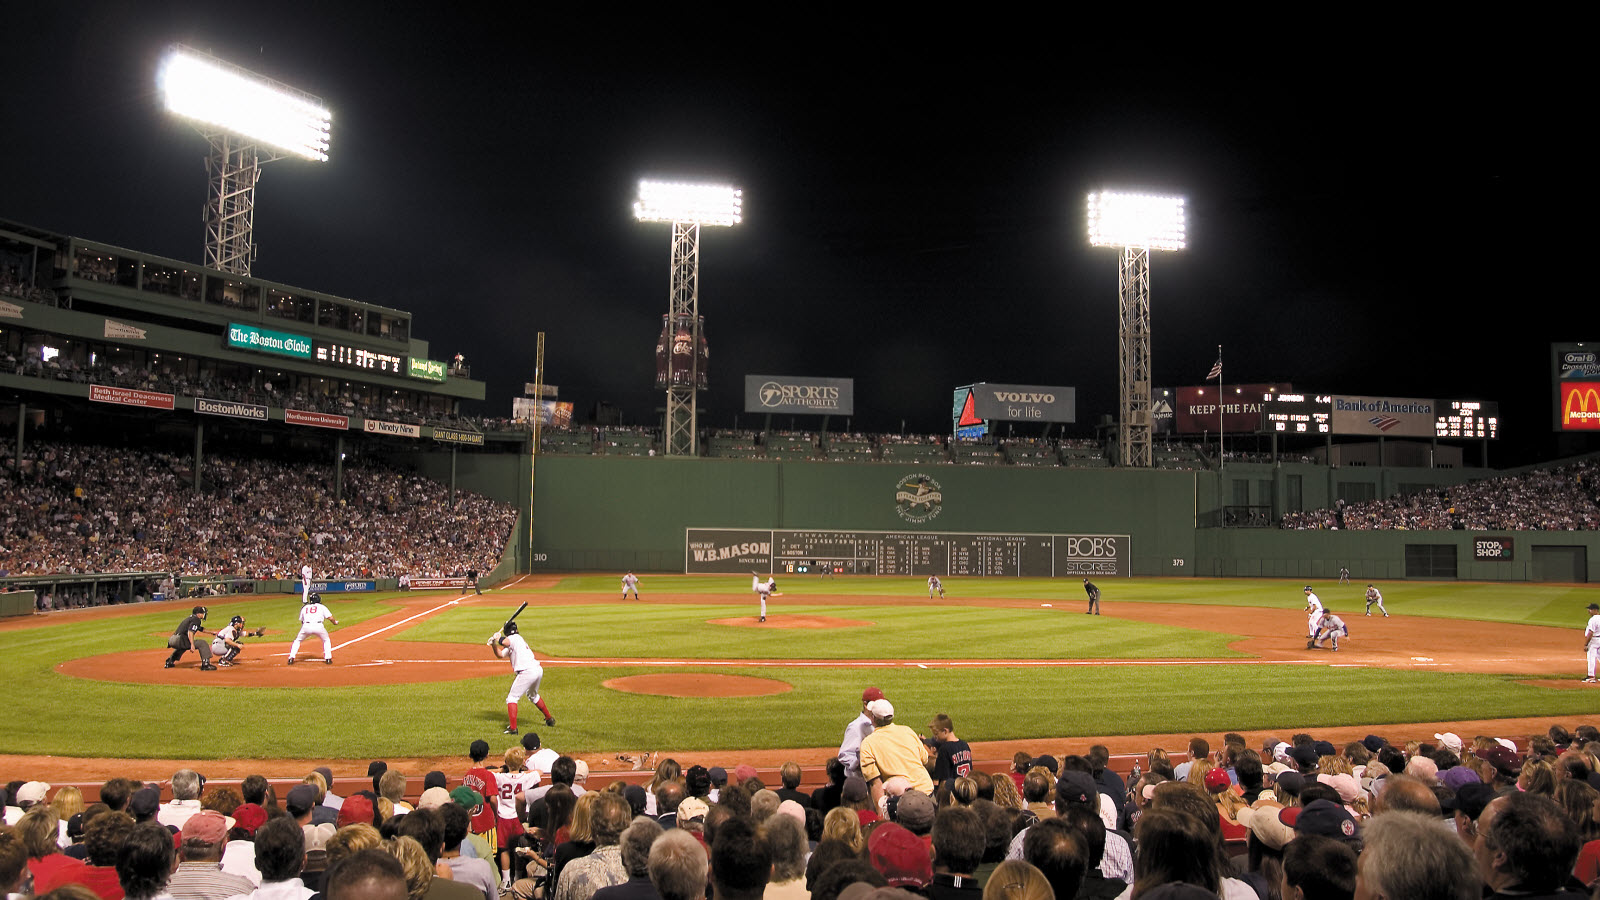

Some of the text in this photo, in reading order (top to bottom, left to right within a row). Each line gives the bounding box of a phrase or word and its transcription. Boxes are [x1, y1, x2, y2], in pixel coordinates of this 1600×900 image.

[230, 328, 310, 353] The Boston Globe
[368, 359, 374, 368] 2
[381, 361, 386, 370] 0
[393, 363, 398, 372] 2
[133, 391, 172, 402] Deaconess
[782, 385, 838, 399] SPORTS
[994, 392, 1055, 403] VOLVO
[94, 394, 147, 405] Medical Center
[782, 398, 837, 406] AUTHORITY
[1336, 399, 1431, 413] Bank of America
[200, 401, 264, 418] BostonWorks
[1008, 405, 1041, 418] for life
[1190, 405, 1215, 414] KEEP
[1219, 404, 1240, 413] THE
[287, 413, 346, 426] Northeastern University
[379, 422, 399, 433] Ninety
[400, 424, 413, 433] Nine
[446, 432, 458, 440] GLASS
[896, 474, 917, 489] BOSTON
[931, 479, 941, 490] SOX
[896, 505, 904, 517] THE
[928, 506, 942, 520] FUND
[694, 542, 770, 562] W.B.MASON
[1068, 538, 1116, 557] BOB'S
[1067, 562, 1115, 570] STORES
[957, 763, 970, 777] 7
[502, 784, 523, 800] 24
